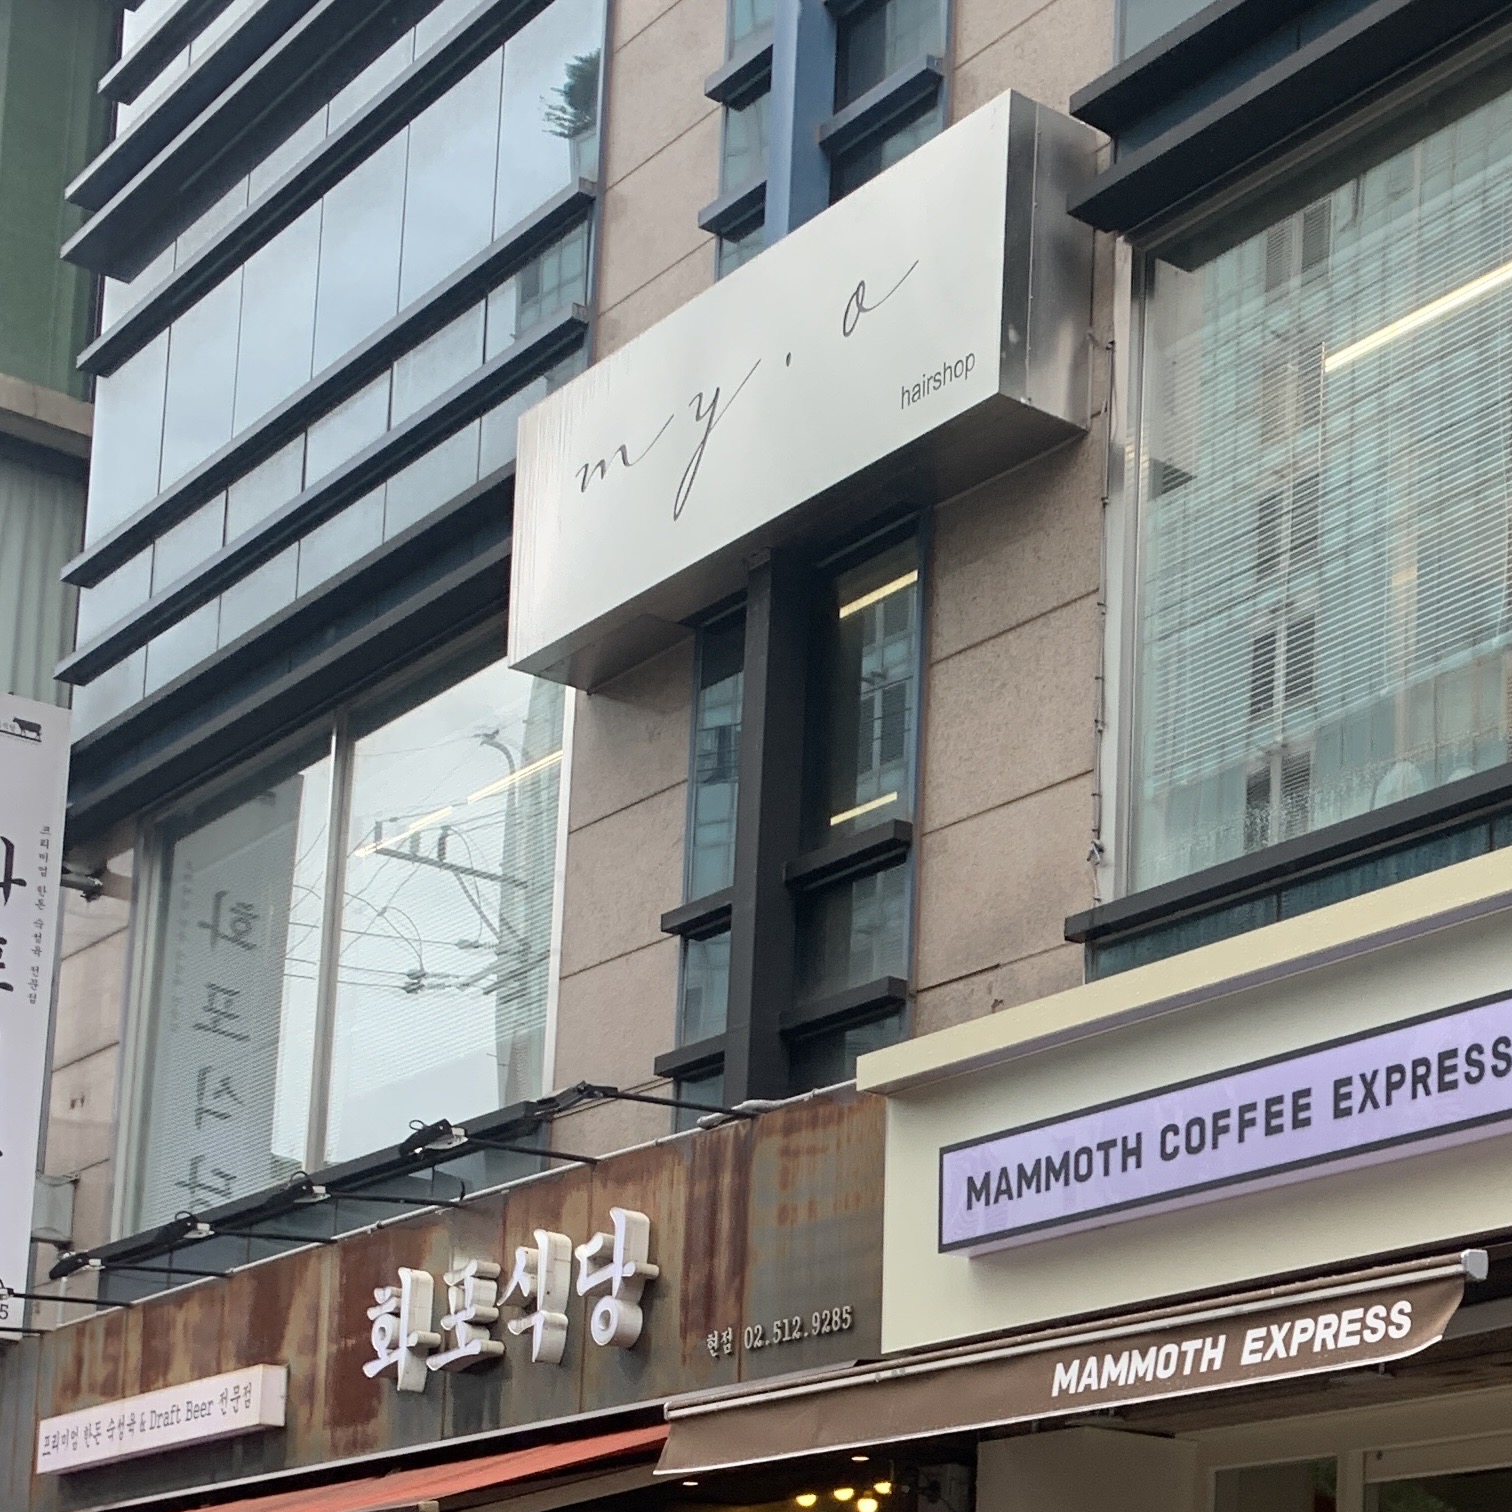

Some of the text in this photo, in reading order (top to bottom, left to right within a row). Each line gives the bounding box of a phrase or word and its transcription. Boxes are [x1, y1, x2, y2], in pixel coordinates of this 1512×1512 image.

[900, 351, 976, 410] hairshop
[965, 1130, 1144, 1213] MAMMOTH
[1159, 1086, 1313, 1163] COFFEE
[361, 1206, 660, 1392] 화포식당
[743, 1305, 853, 1350] 02.512.9285
[1050, 1300, 1413, 1398] MAMMOTH EXPRESS
[41, 1425, 79, 1456] 프리미엄
[149, 1403, 182, 1431] Draft
[185, 1399, 214, 1422] Beer
[218, 1381, 253, 1416] 전문점
